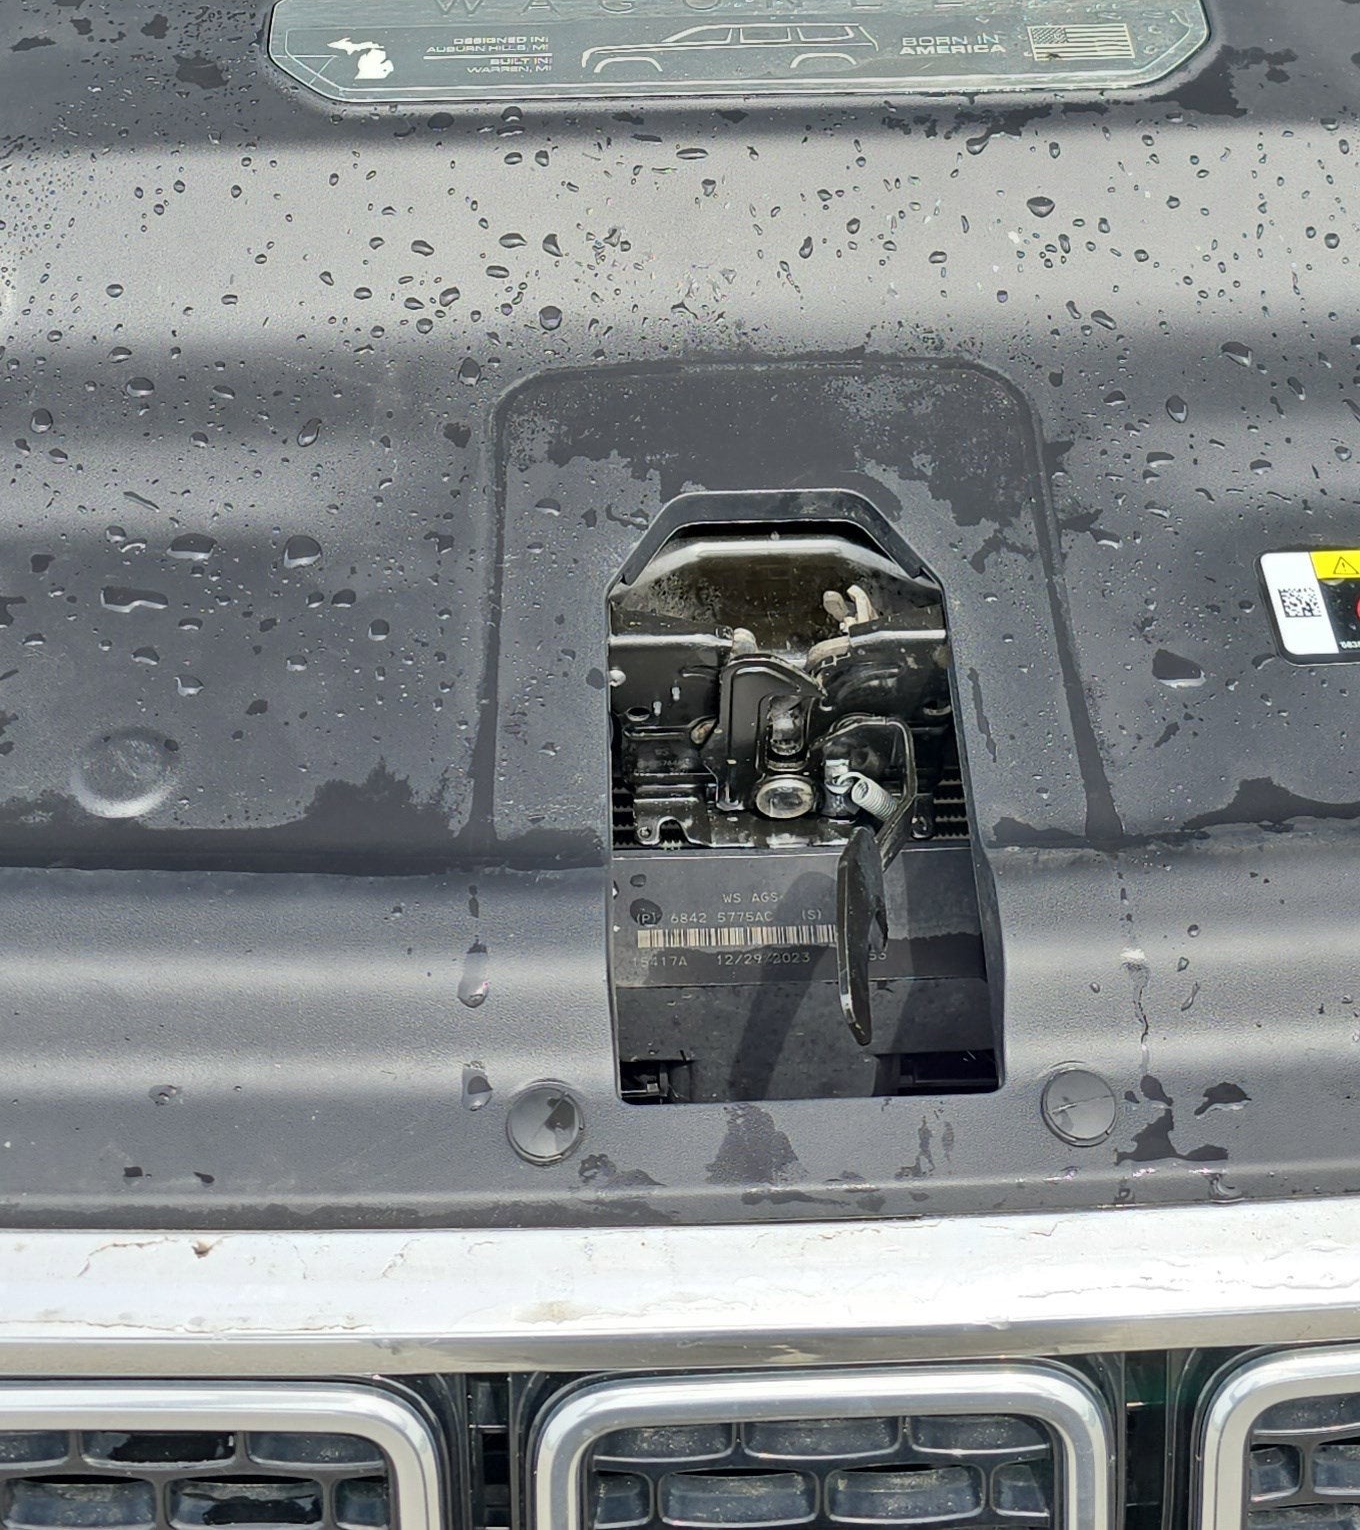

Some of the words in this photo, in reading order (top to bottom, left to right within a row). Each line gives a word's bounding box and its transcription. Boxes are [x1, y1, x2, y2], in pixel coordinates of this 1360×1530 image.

[453, 36, 528, 45] DESIGNED
[902, 37, 969, 46] BORN
[976, 34, 1000, 44] IN
[426, 45, 486, 53] AUBURN
[899, 44, 1007, 55] AMERICA
[466, 66, 532, 74] WARREN,
[722, 893, 742, 904] WS
[637, 912, 656, 924] (P)
[670, 912, 707, 924] 6842
[717, 911, 774, 923] 5775AC
[802, 909, 822, 920] (S)
[717, 952, 811, 966] 12/29/2023
